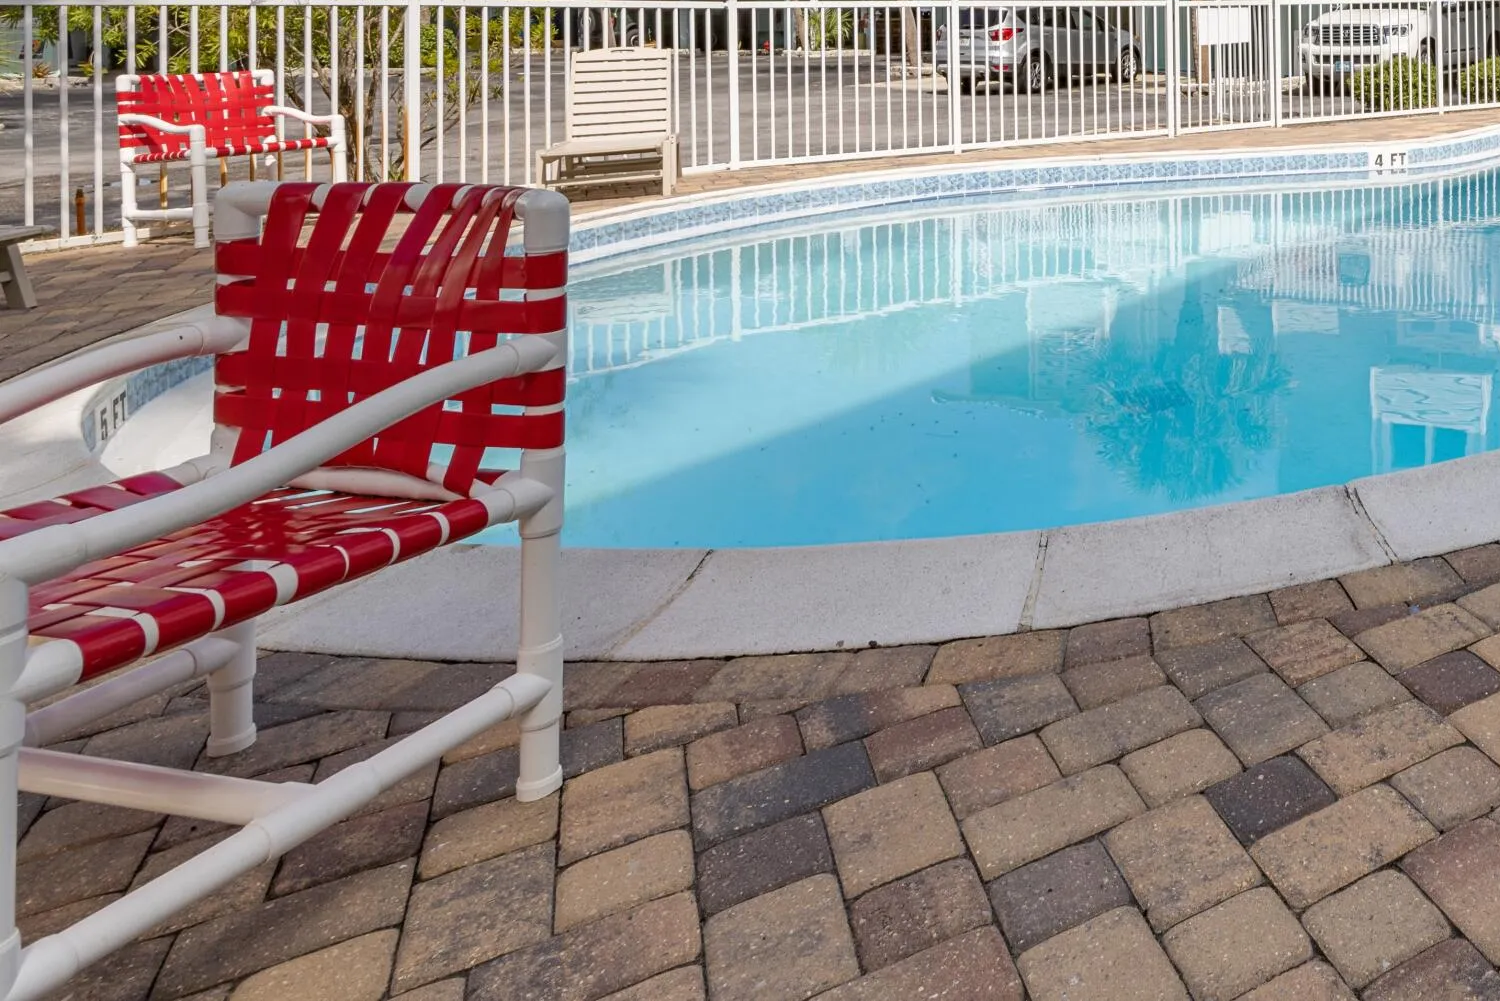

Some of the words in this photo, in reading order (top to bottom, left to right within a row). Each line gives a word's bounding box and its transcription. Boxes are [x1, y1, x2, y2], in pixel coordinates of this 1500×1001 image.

[1375, 154, 1383, 166] 4
[1391, 153, 1406, 166] FT
[100, 407, 108, 440] 5
[113, 390, 126, 429] FT
